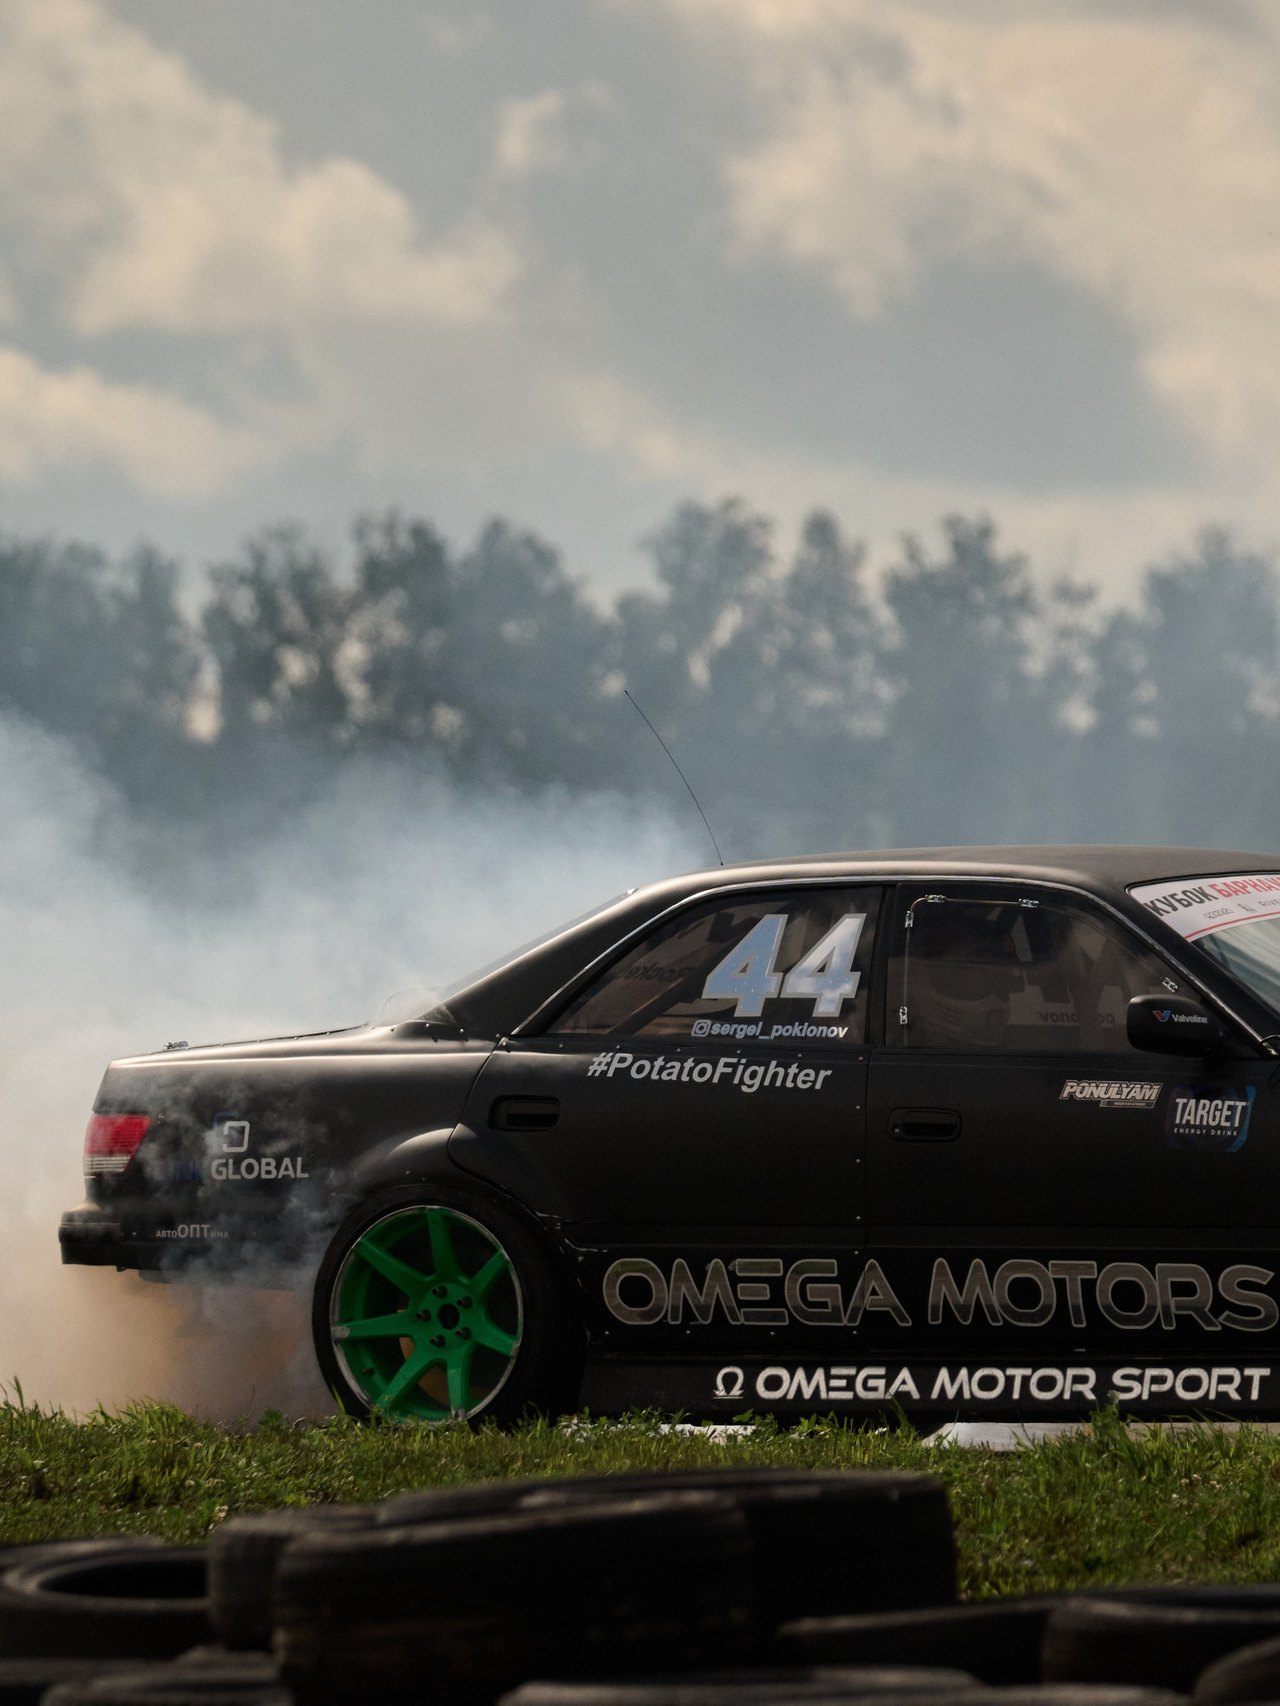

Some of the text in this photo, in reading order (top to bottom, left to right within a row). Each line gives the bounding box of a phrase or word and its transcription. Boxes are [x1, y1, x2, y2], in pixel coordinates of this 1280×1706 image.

[1144, 886, 1219, 917] КУБОК
[701, 913, 867, 1017] 44
[1171, 1013, 1208, 1024] Valvoline
[587, 1052, 832, 1093] #PotatoFighter
[1062, 1082, 1160, 1101] PONULYAM
[1174, 1098, 1247, 1127] TARGET
[1174, 1127, 1239, 1137] ENERGY DRINK
[211, 1157, 309, 1180] GLOBAL
[602, 1257, 1279, 1331] OMEGA MOTORS
[755, 1366, 920, 1400] OMEGA
[931, 1366, 1097, 1400] MOTOR
[1111, 1366, 1272, 1400] SPORT
